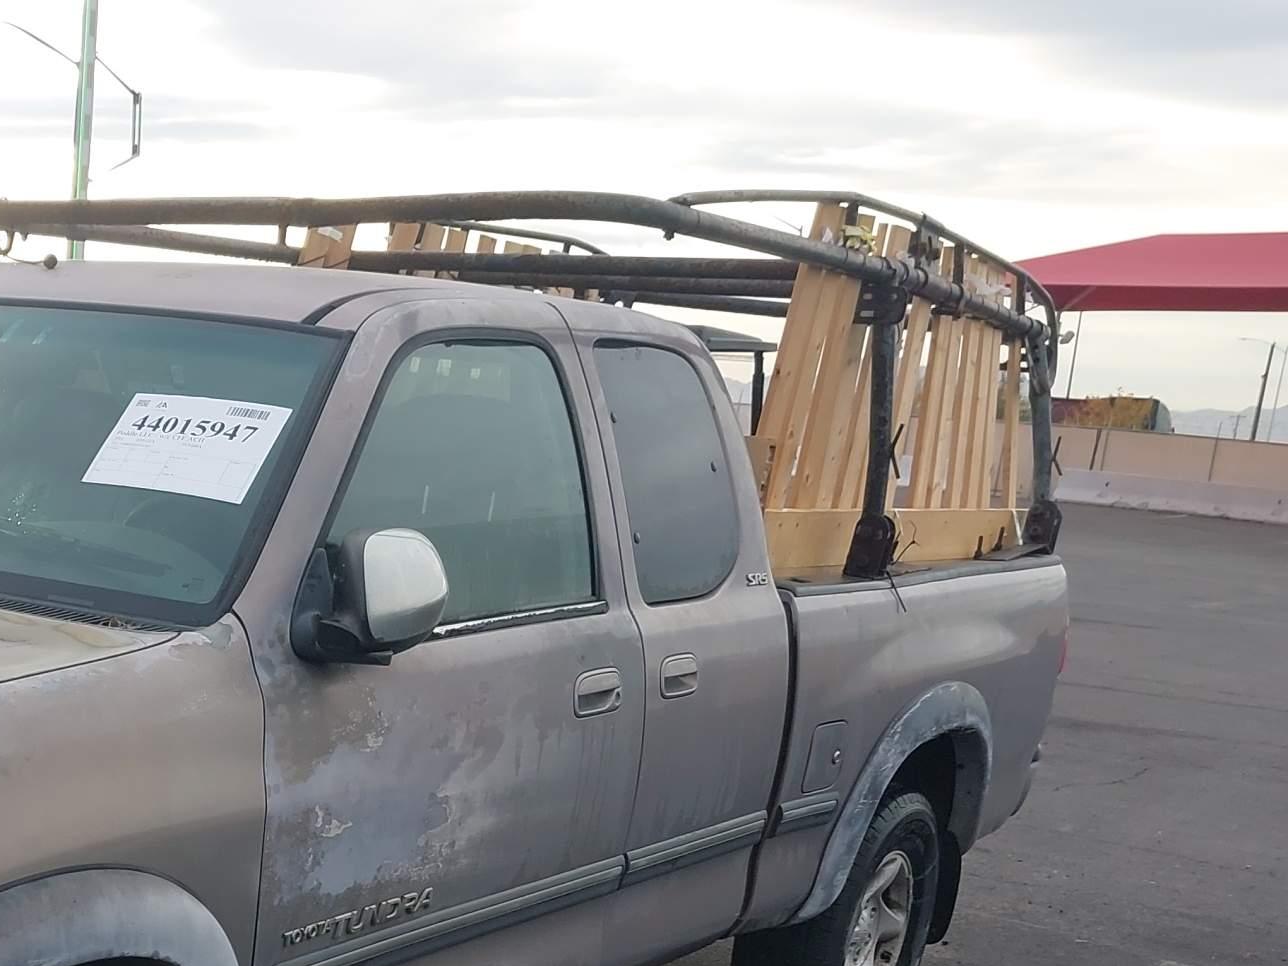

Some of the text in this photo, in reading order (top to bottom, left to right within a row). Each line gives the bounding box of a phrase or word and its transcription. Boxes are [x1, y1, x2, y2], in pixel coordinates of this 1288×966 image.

[132, 414, 259, 443] 44015947
[282, 887, 434, 948] TOYOTA TUNDRA
